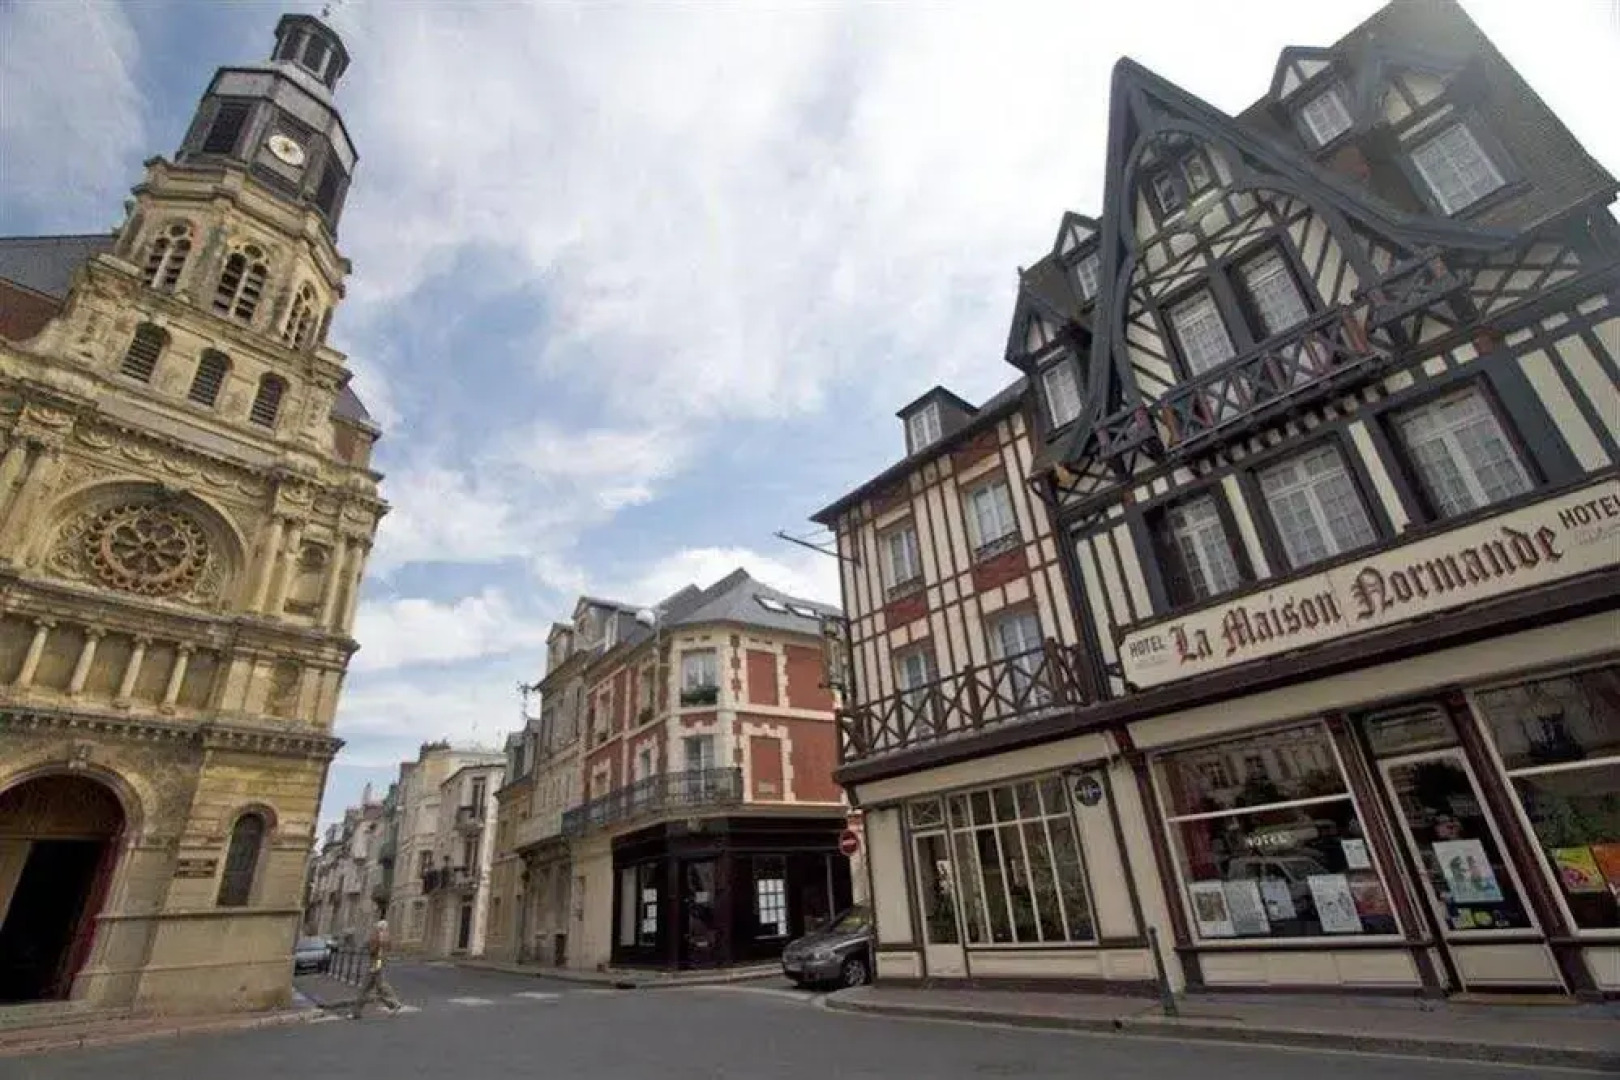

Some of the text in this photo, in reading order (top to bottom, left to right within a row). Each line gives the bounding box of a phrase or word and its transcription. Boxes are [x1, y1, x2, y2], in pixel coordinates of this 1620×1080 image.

[1168, 526, 1564, 665] La Maison Normande
[1128, 634, 1167, 659] HOTEL
